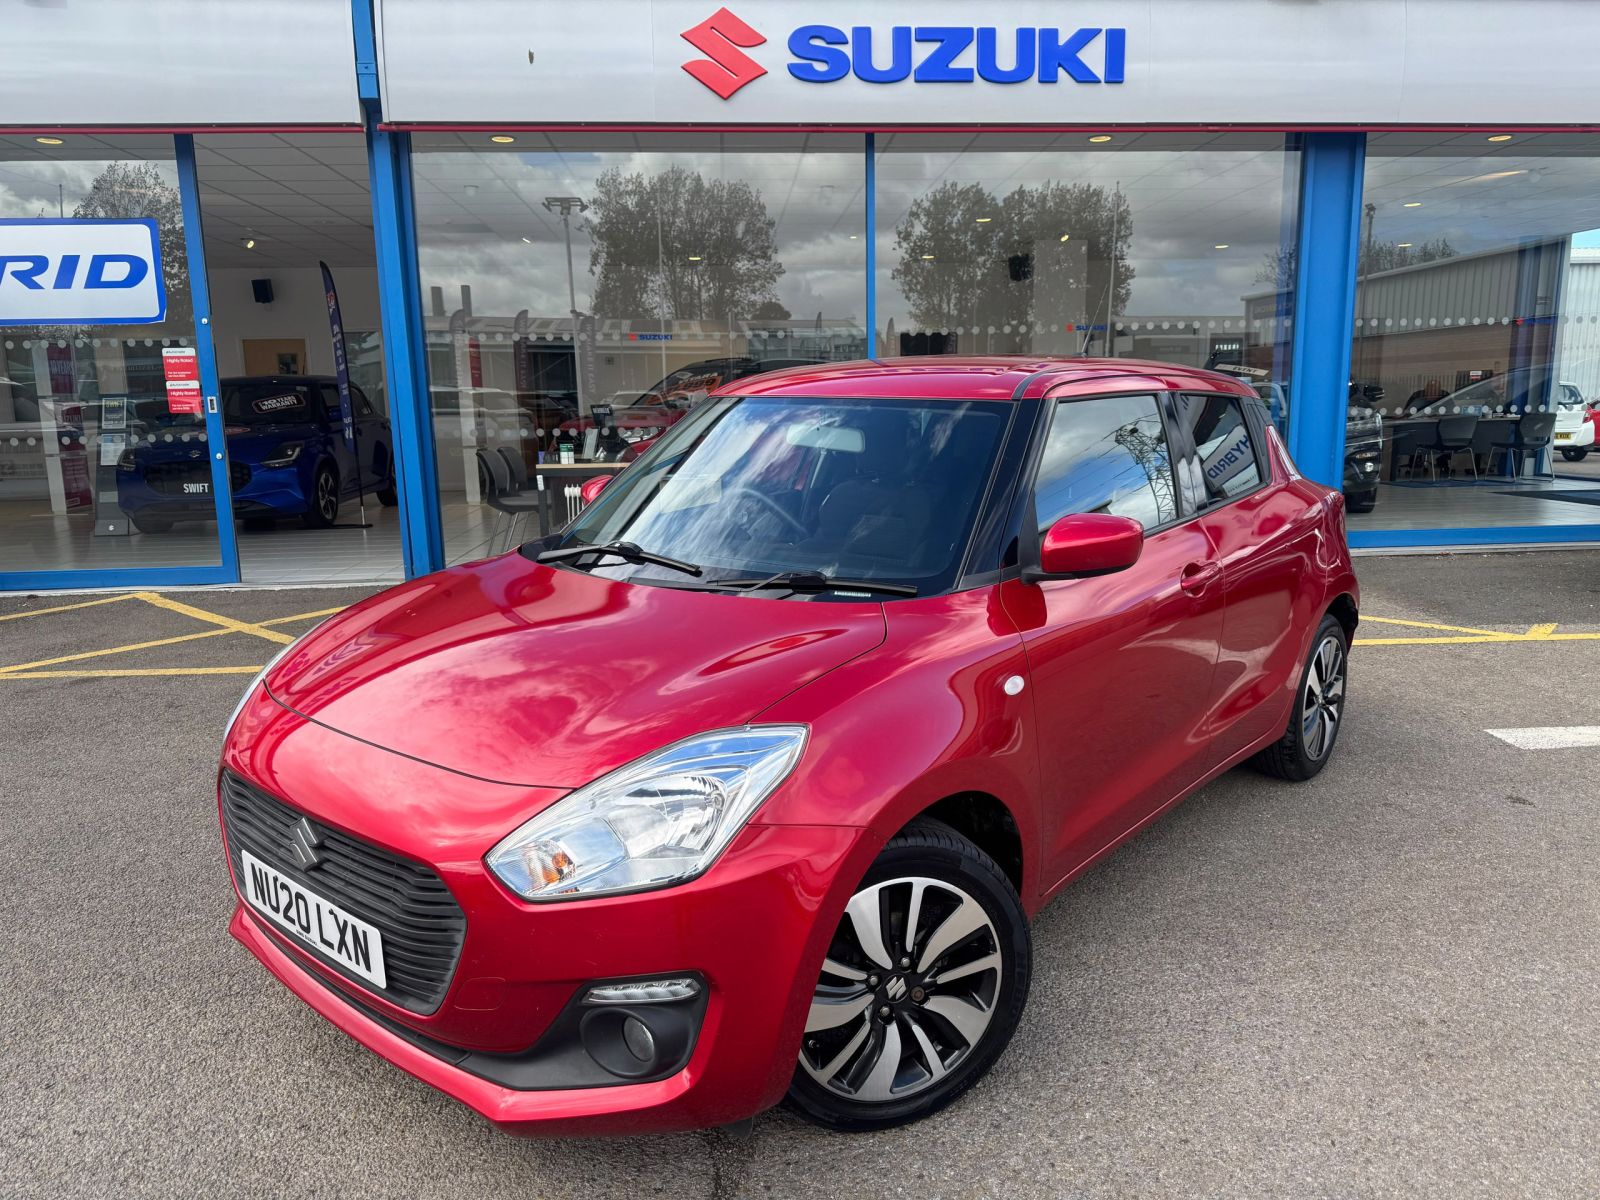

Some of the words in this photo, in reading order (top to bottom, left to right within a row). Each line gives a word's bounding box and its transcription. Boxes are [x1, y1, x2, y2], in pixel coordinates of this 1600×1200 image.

[787, 25, 1126, 84] SUZUKI
[0, 254, 149, 290] RID
[183, 483, 209, 493] SWIFT
[251, 862, 311, 934] NU20
[316, 903, 372, 973] LXN
